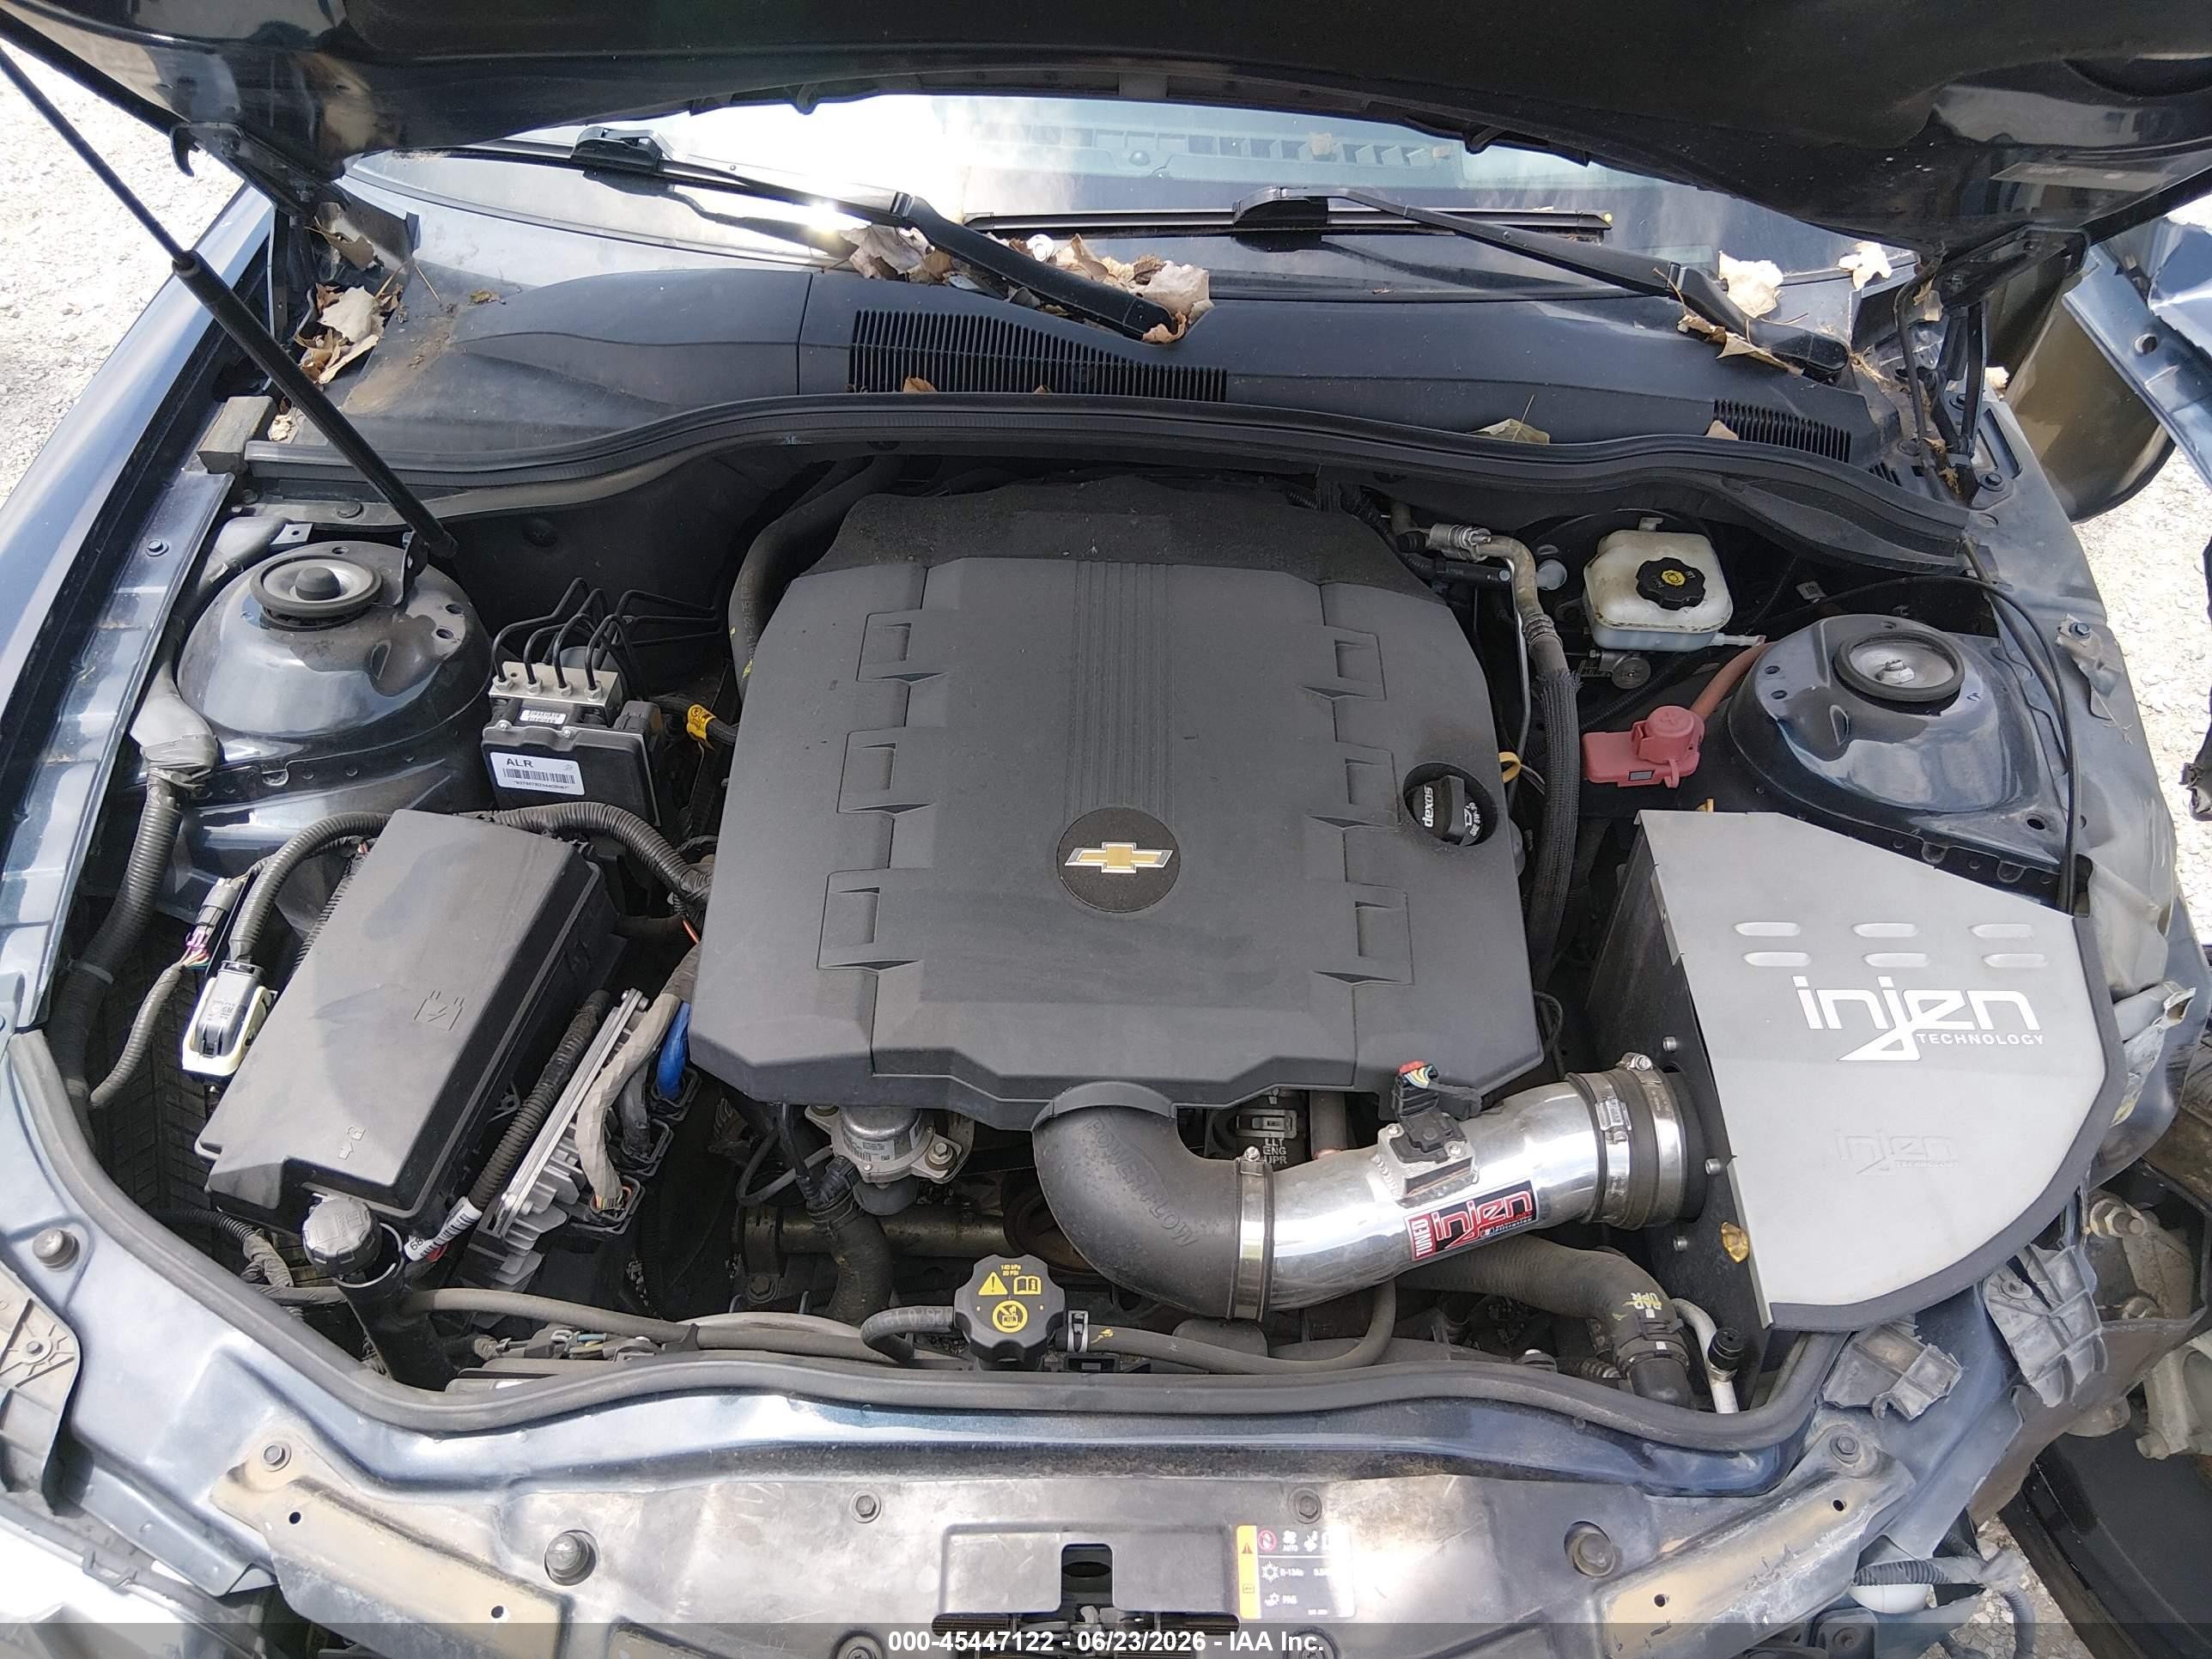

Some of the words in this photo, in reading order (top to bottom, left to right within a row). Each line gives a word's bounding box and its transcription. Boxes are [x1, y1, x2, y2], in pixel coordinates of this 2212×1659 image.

[507, 758, 533, 768] ALR
[1422, 785, 1434, 828] dexos
[1792, 975, 2041, 1060] injen
[1915, 1033, 2045, 1046] TECHNOLOGY
[1263, 1146, 1286, 1155] ENG
[1265, 1138, 1284, 1146] LLT
[1834, 1126, 1954, 1176] injen
[1432, 1190, 1533, 1247] injen
[410, 1237, 423, 1251] 68
[1411, 1220, 1429, 1258] TUNED
